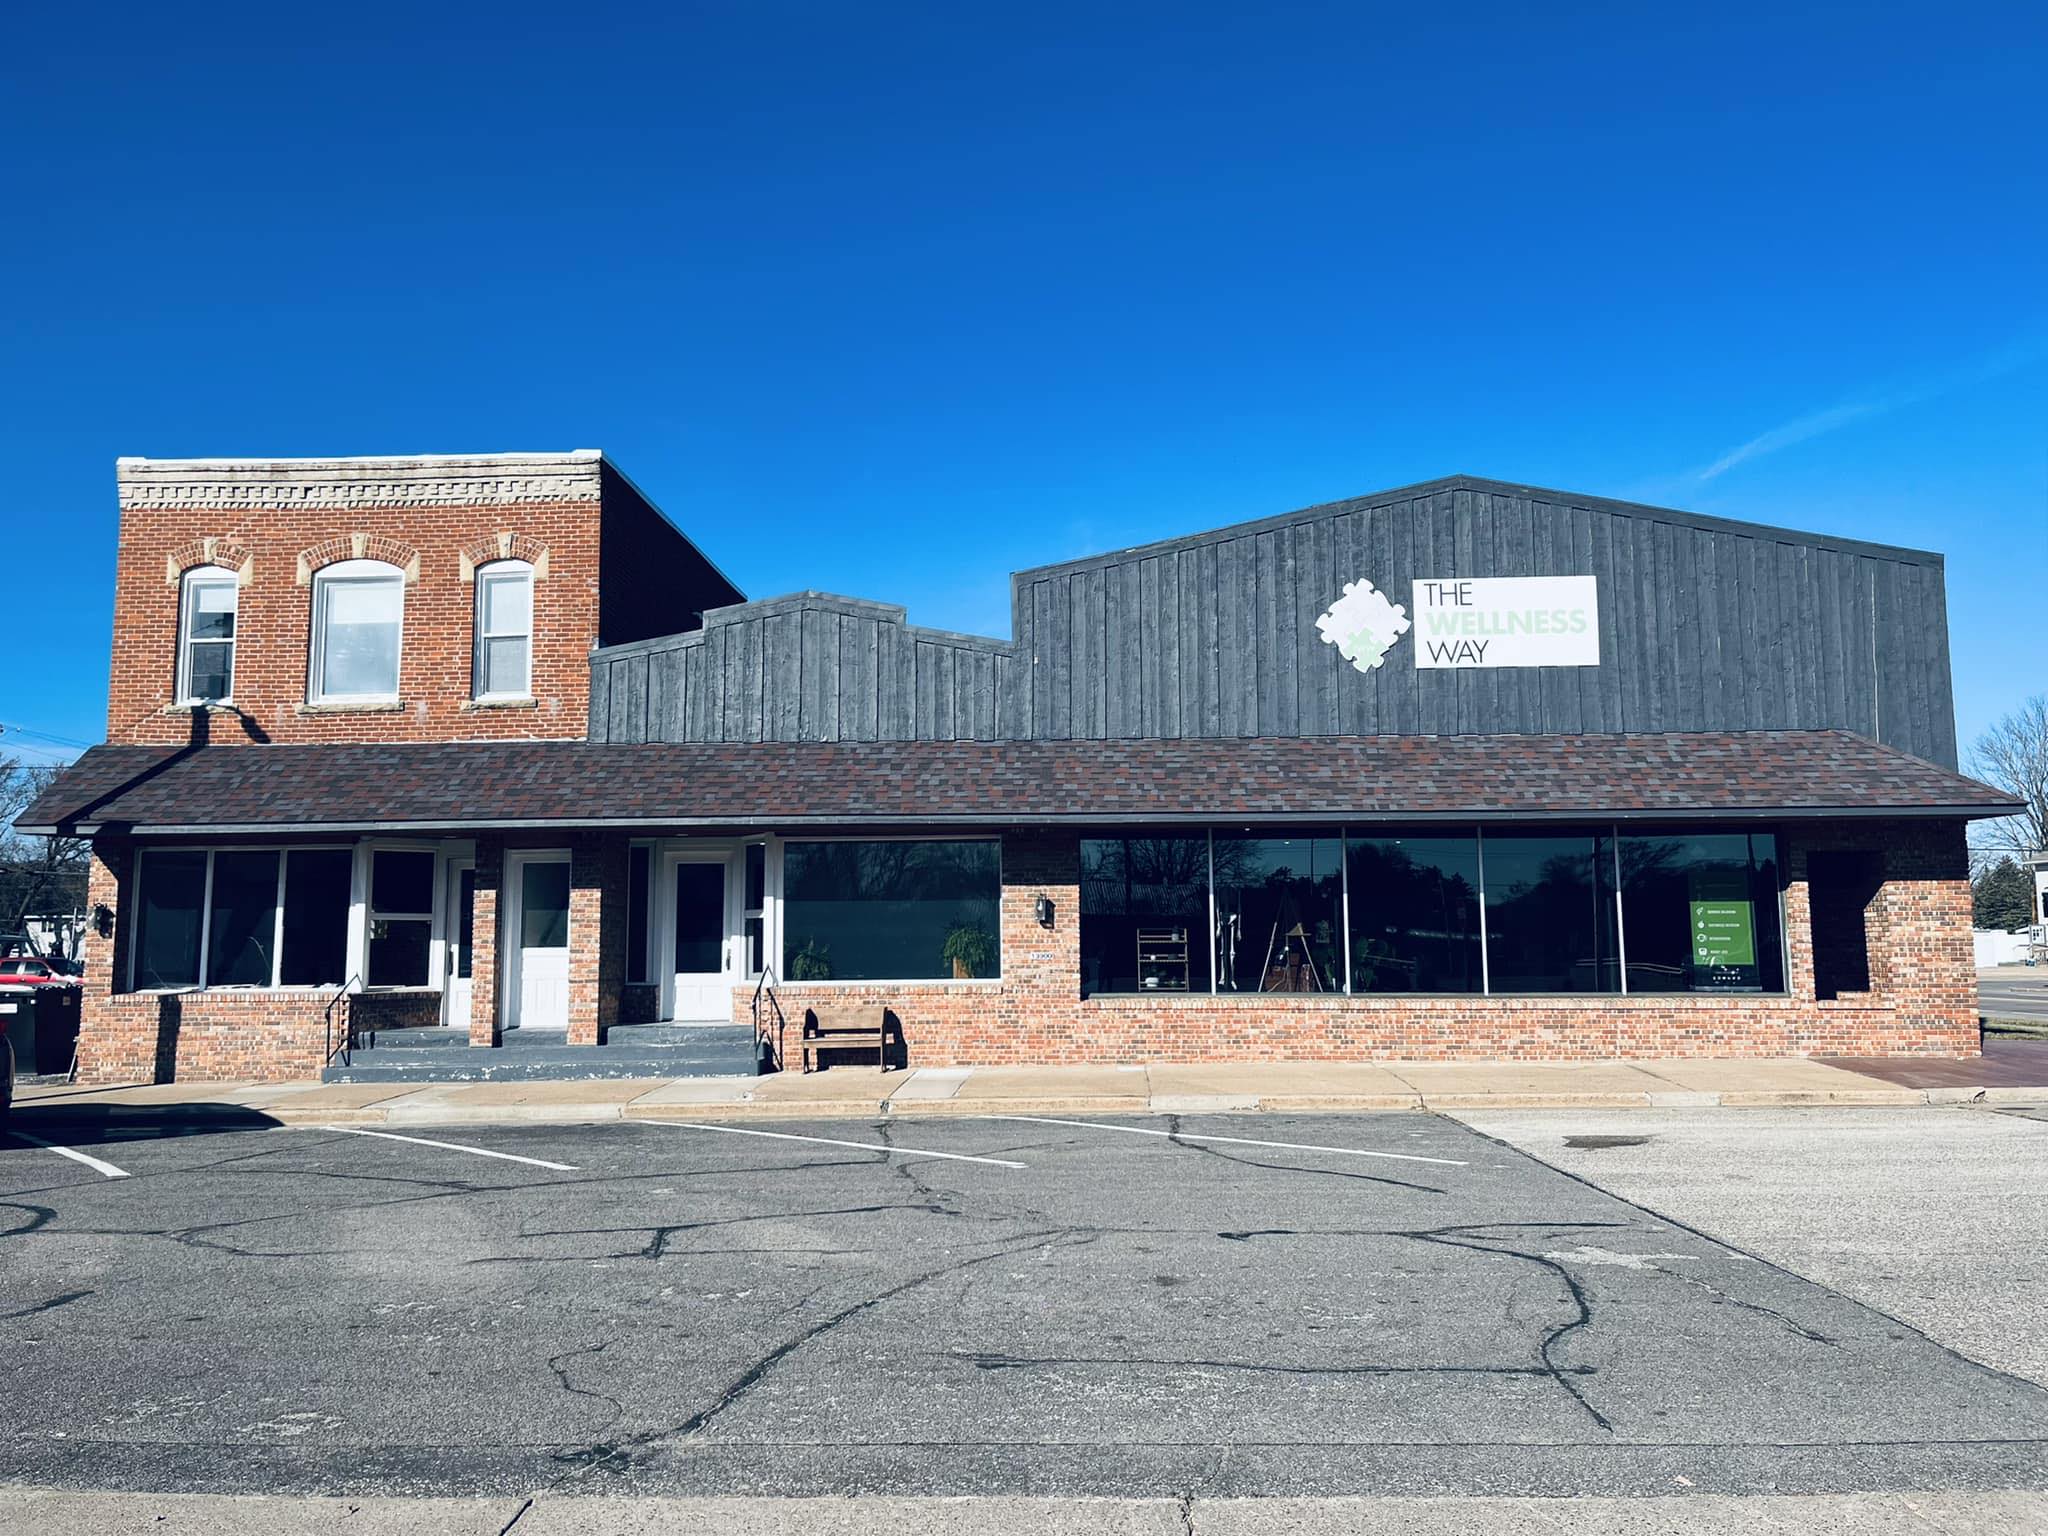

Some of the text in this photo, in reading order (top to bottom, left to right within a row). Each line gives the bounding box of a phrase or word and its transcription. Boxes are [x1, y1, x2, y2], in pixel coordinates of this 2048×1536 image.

[1424, 582, 1473, 606] THE
[1424, 608, 1587, 636] WELLNESS
[1427, 640, 1489, 664] WAY
